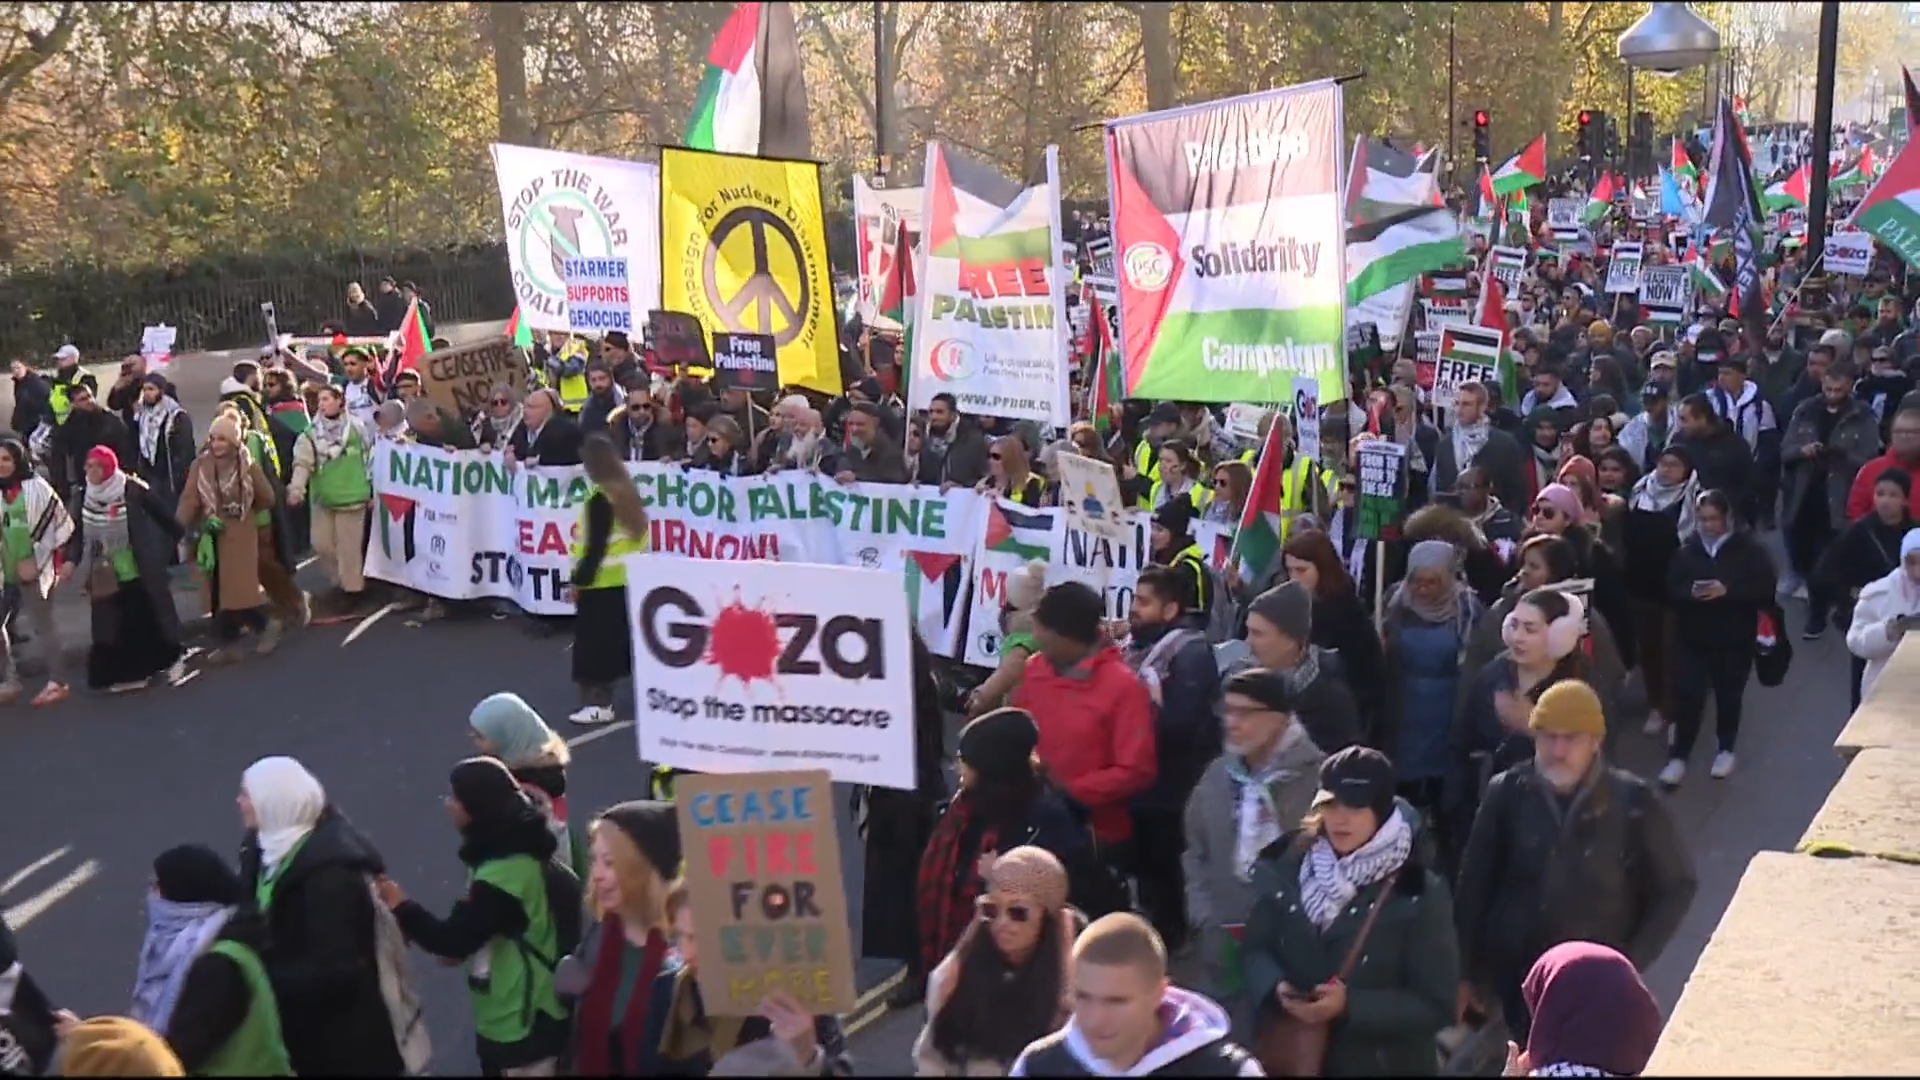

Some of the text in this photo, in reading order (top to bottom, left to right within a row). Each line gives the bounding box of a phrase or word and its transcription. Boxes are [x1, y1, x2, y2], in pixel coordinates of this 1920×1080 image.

[1184, 130, 1310, 177] Palestine
[508, 168, 628, 246] STOP THE WAR
[719, 183, 782, 209] Nuclear
[565, 259, 626, 278] STARMER
[1191, 236, 1321, 278] Solidarity
[1825, 243, 1868, 260] Gza
[514, 269, 565, 316] COALI
[567, 284, 629, 303] SUPPORTS
[1646, 284, 1678, 303] NOW!
[568, 309, 632, 329] GENOCIDE
[715, 352, 776, 372] Palestine
[729, 336, 761, 353] Free
[1202, 336, 1336, 378] Campaign
[1438, 359, 1494, 382] FREE
[390, 449, 514, 496] NATION
[527, 474, 685, 510] MACH
[686, 480, 736, 522] OR
[640, 585, 886, 681] Gza
[647, 687, 892, 730] Stop the massacre
[690, 785, 814, 827] CEASE
[707, 832, 819, 878] FIRE
[730, 881, 824, 921] FOR
[719, 924, 828, 966] EVER
[728, 967, 836, 1006] MORE
